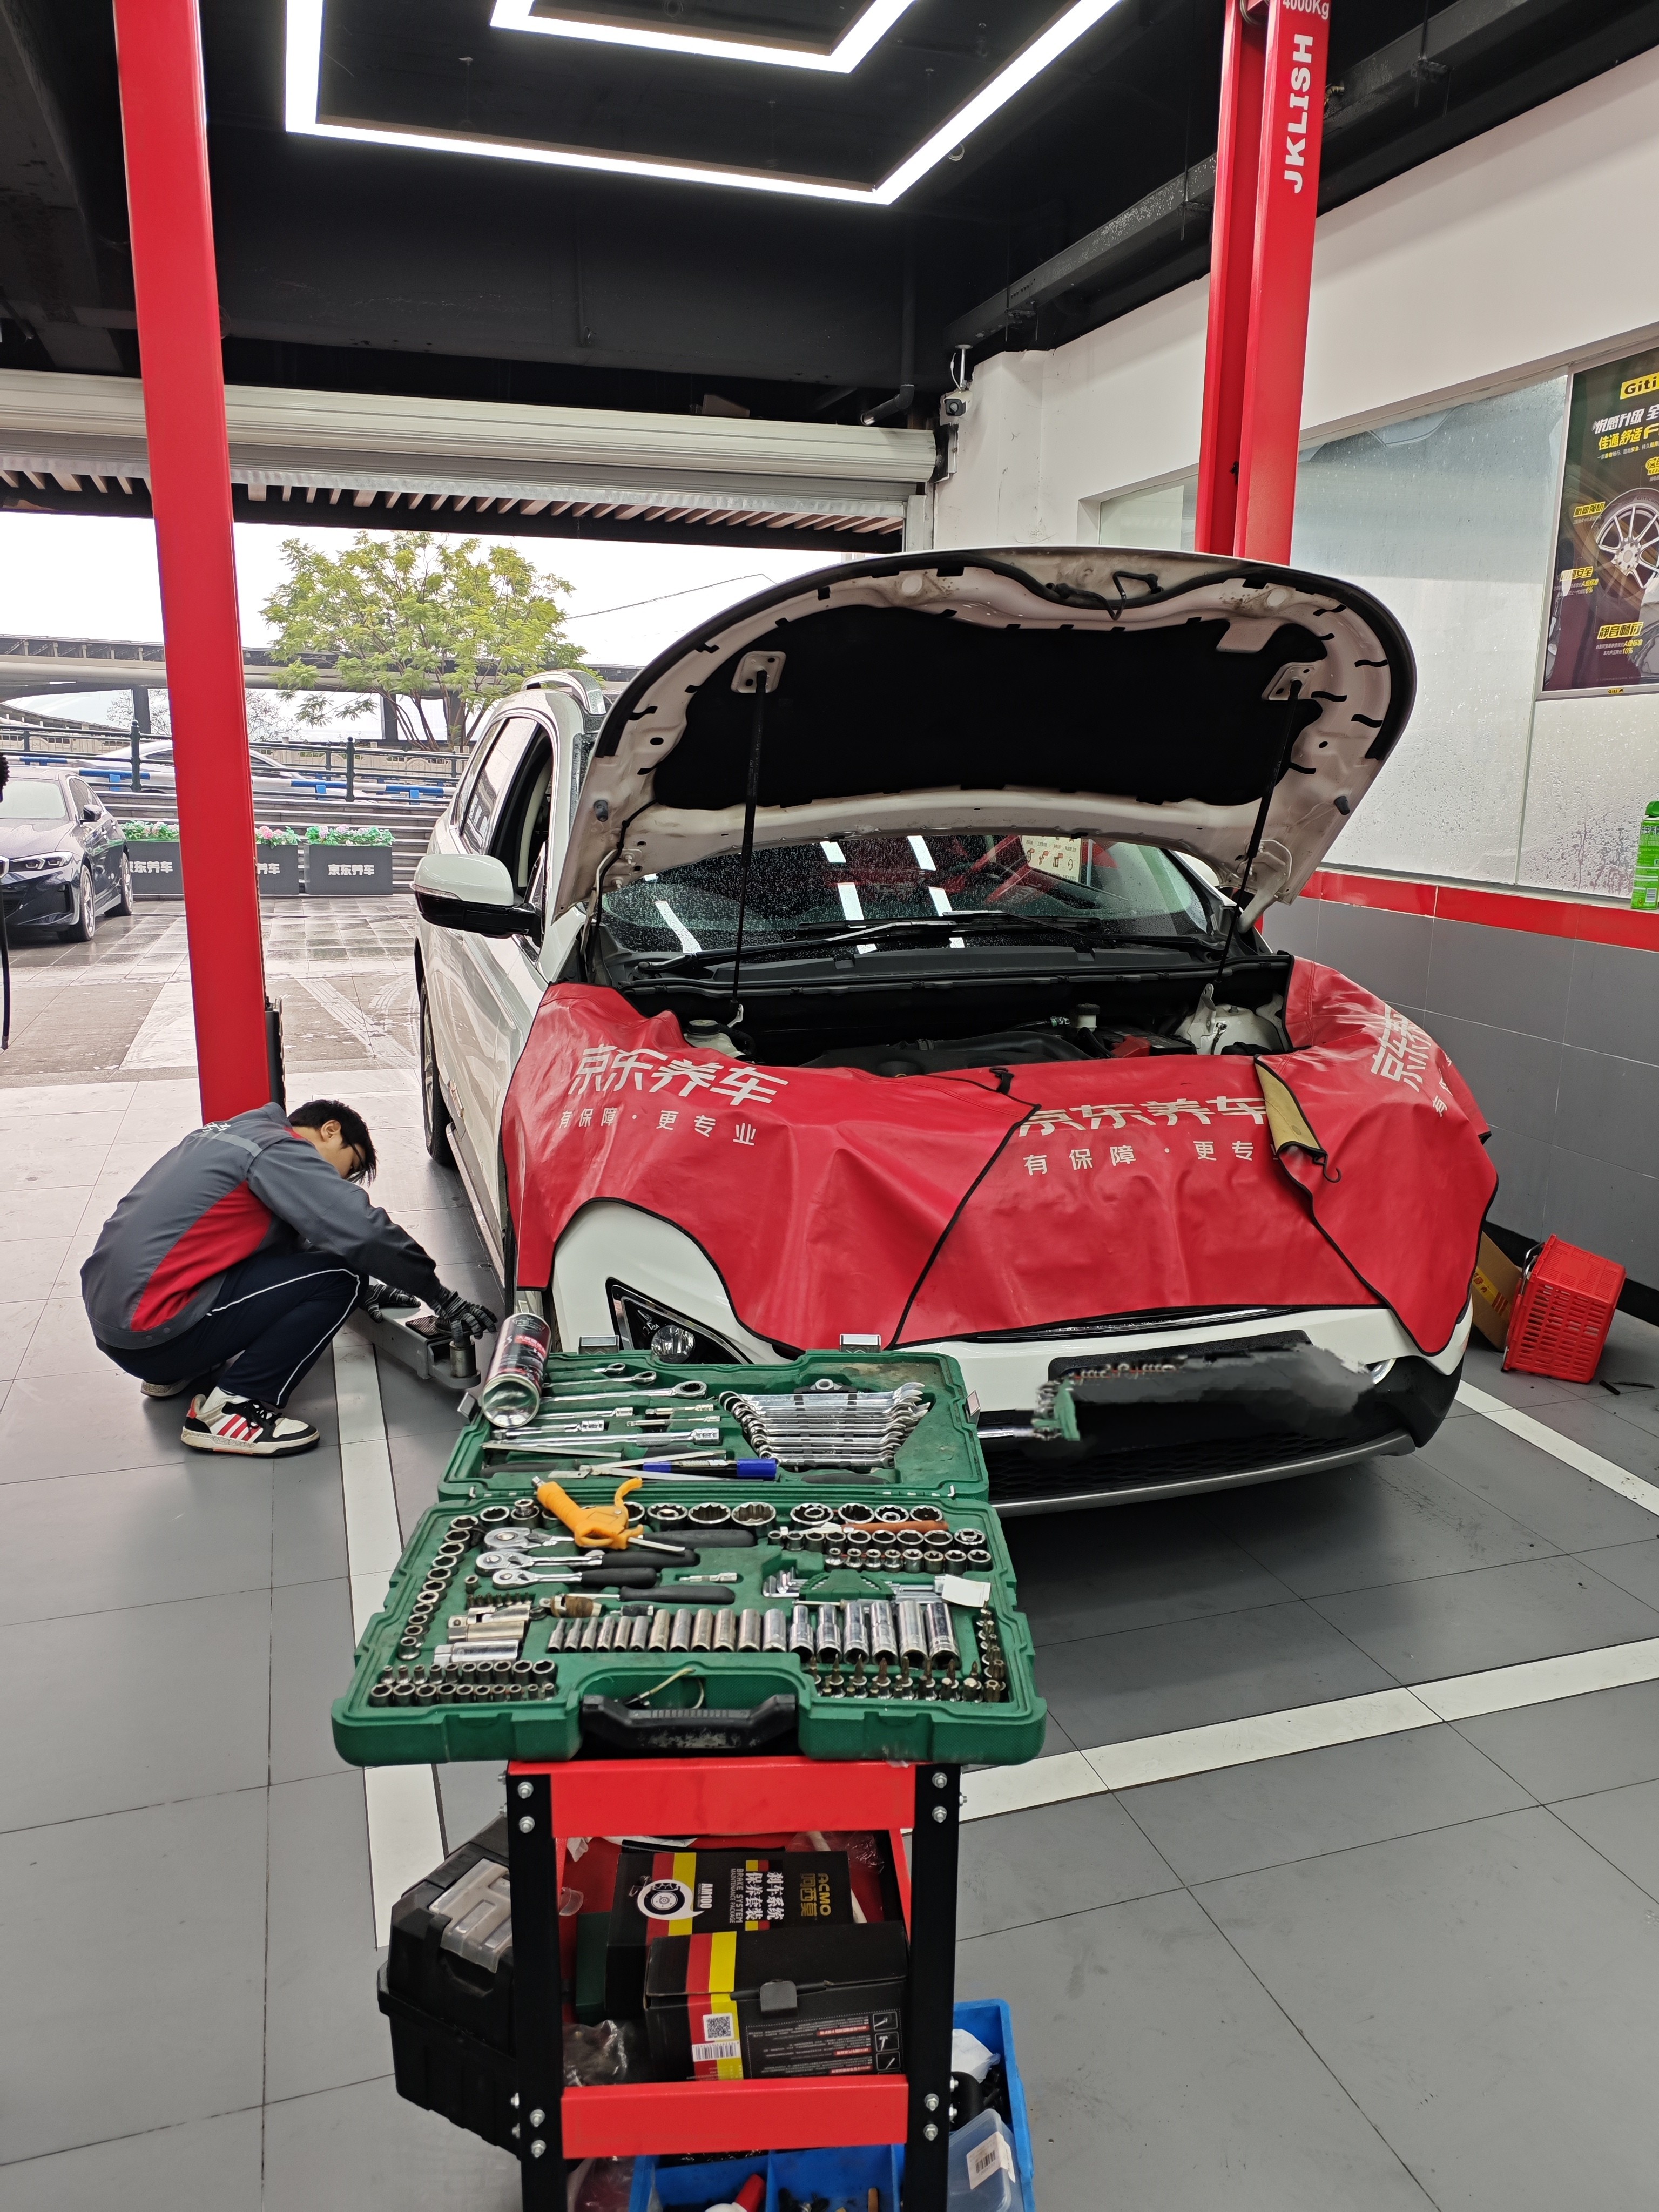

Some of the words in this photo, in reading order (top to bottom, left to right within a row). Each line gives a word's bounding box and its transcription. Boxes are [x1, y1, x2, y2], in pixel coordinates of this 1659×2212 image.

[1284, 34, 1313, 193] JKLISH
[1624, 376, 1657, 395] Giti
[1599, 427, 1643, 450] 佳通舒适
[1599, 623, 1643, 638] 静音畅行
[328, 864, 375, 875] 京东养车
[568, 1043, 789, 1105] 京东养车
[1019, 1096, 1267, 1137] 京东养车
[1023, 1140, 1279, 1176] 有保障·更专
[700, 1883, 713, 1908] AM100
[745, 1872, 763, 1920] 保养套装
[766, 1871, 784, 1920] 刹车系统
[818, 1873, 831, 1916] ACMO
